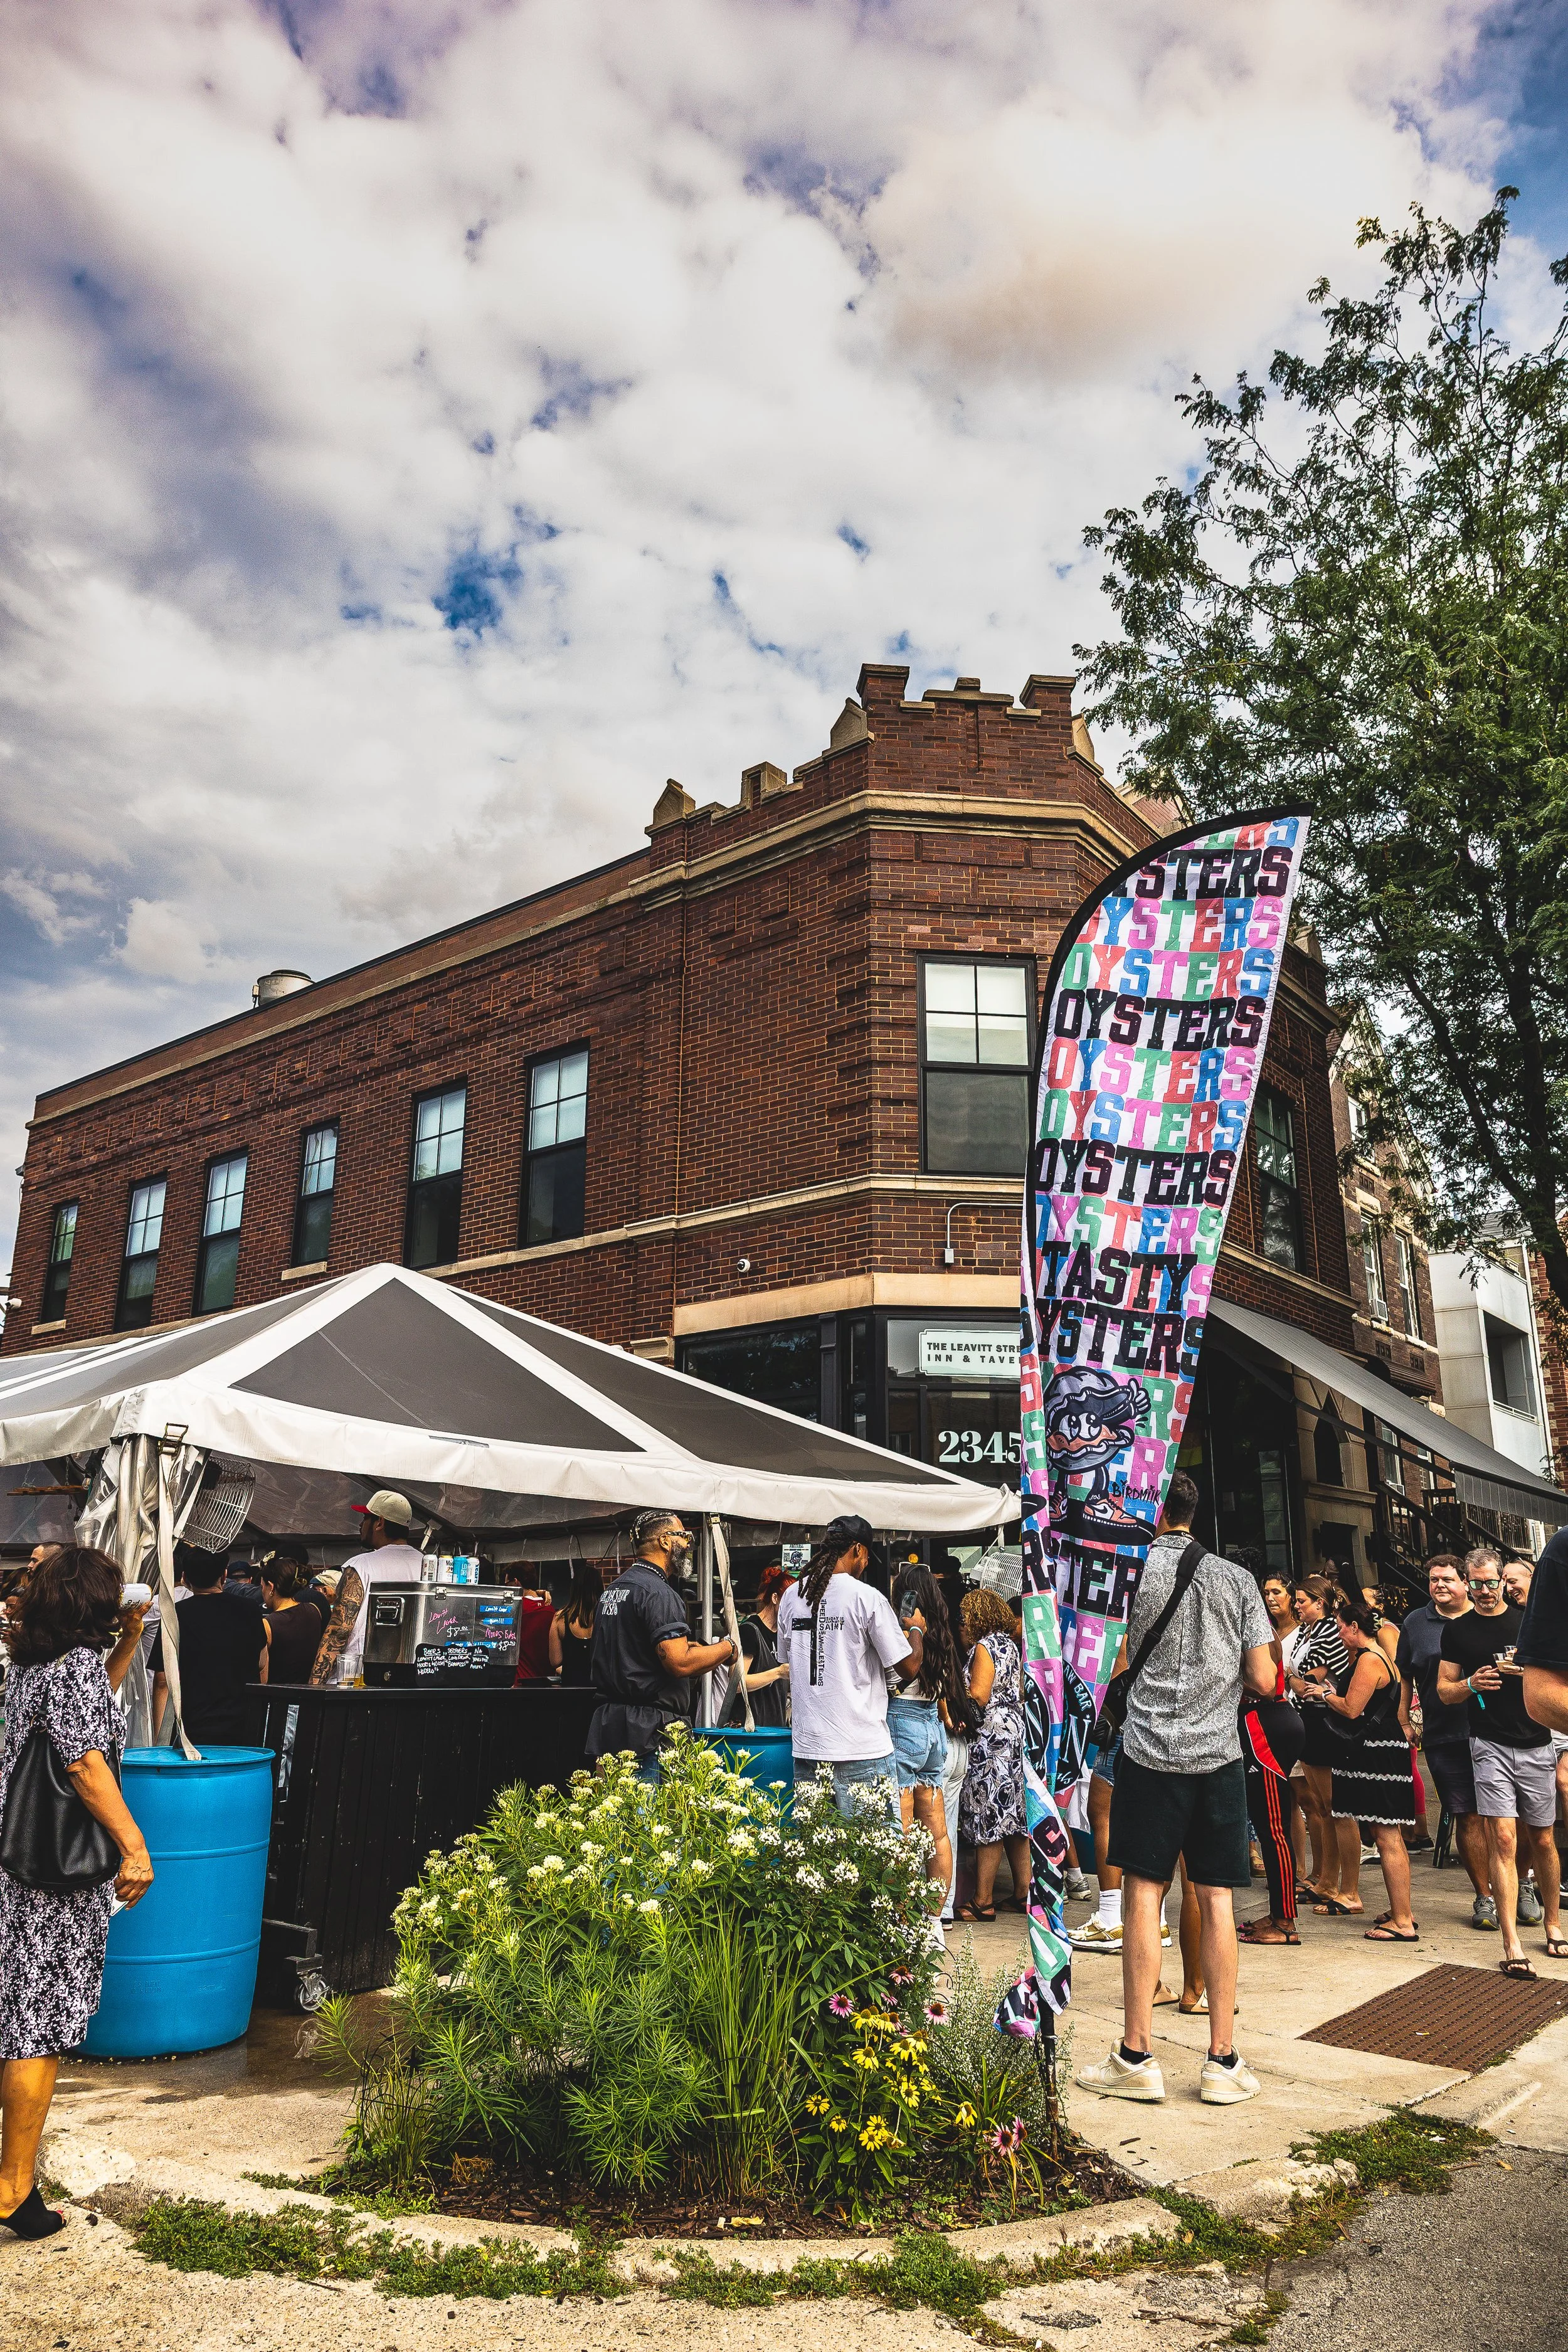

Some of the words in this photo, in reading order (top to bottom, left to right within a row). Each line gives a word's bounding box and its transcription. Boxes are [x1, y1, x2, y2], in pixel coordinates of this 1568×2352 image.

[1062, 943, 1275, 1000] OYSTERS
[1054, 988, 1267, 1051] OYSTERS
[1047, 1037, 1257, 1103] OYSTERS
[1039, 1089, 1247, 1153] OYSTERS
[1036, 1138, 1237, 1209] OYSTERS
[1041, 1241, 1198, 1311] TASTY
[927, 1342, 947, 1350] THE
[951, 1343, 992, 1352] LEAVITT
[928, 1353, 953, 1362] INN
[938, 1431, 1021, 1463] 2345
[423, 1648, 441, 1656] BEERS
[1074, 1682, 1092, 1711] BAR
